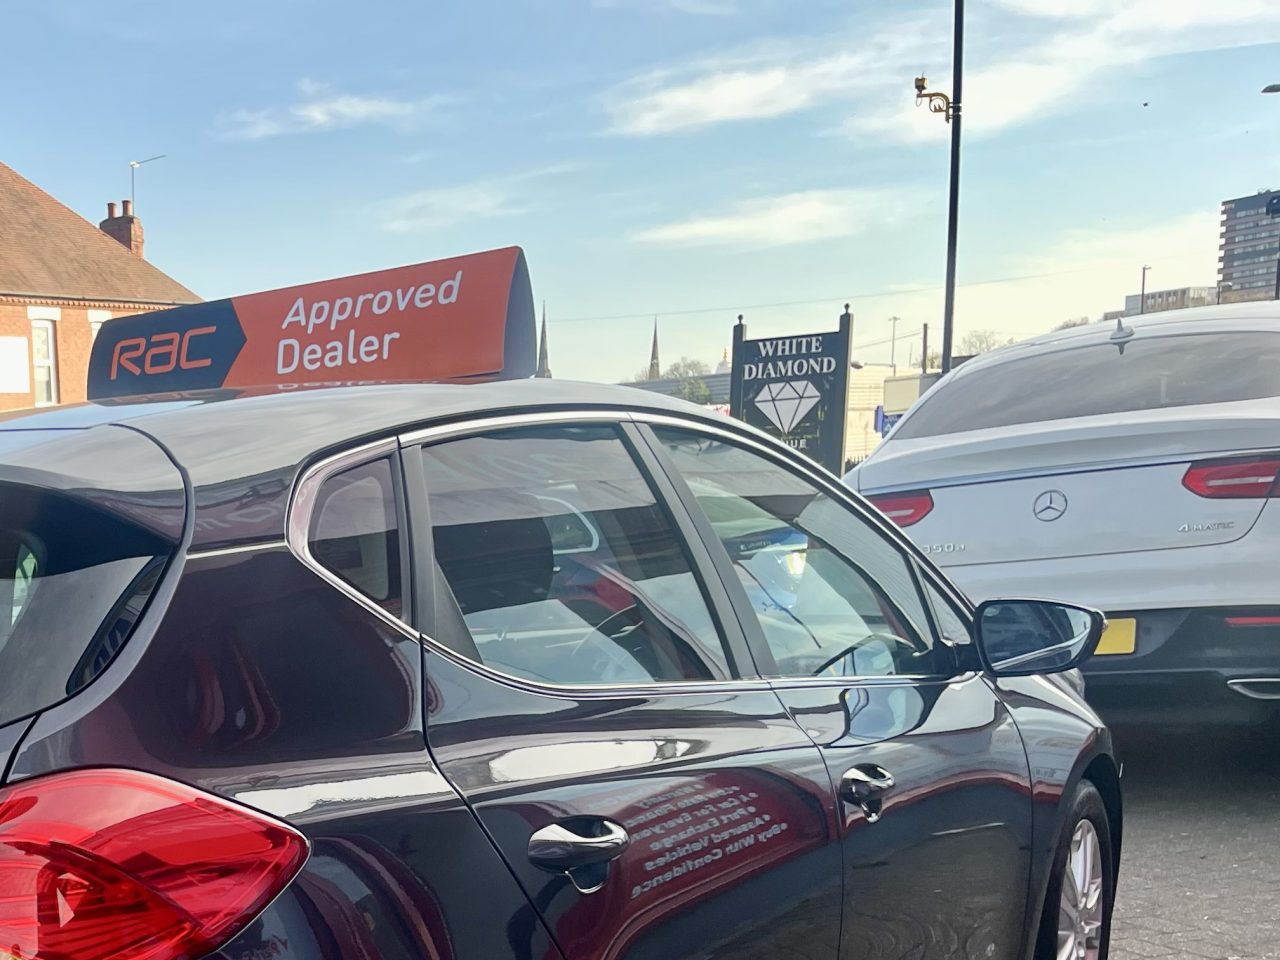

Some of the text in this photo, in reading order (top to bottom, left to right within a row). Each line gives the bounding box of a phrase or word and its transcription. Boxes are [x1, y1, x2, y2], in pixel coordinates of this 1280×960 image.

[281, 270, 463, 334] Approved
[276, 328, 401, 375] Dealer
[758, 336, 822, 358] WHITE
[743, 356, 836, 380] DIAMOND
